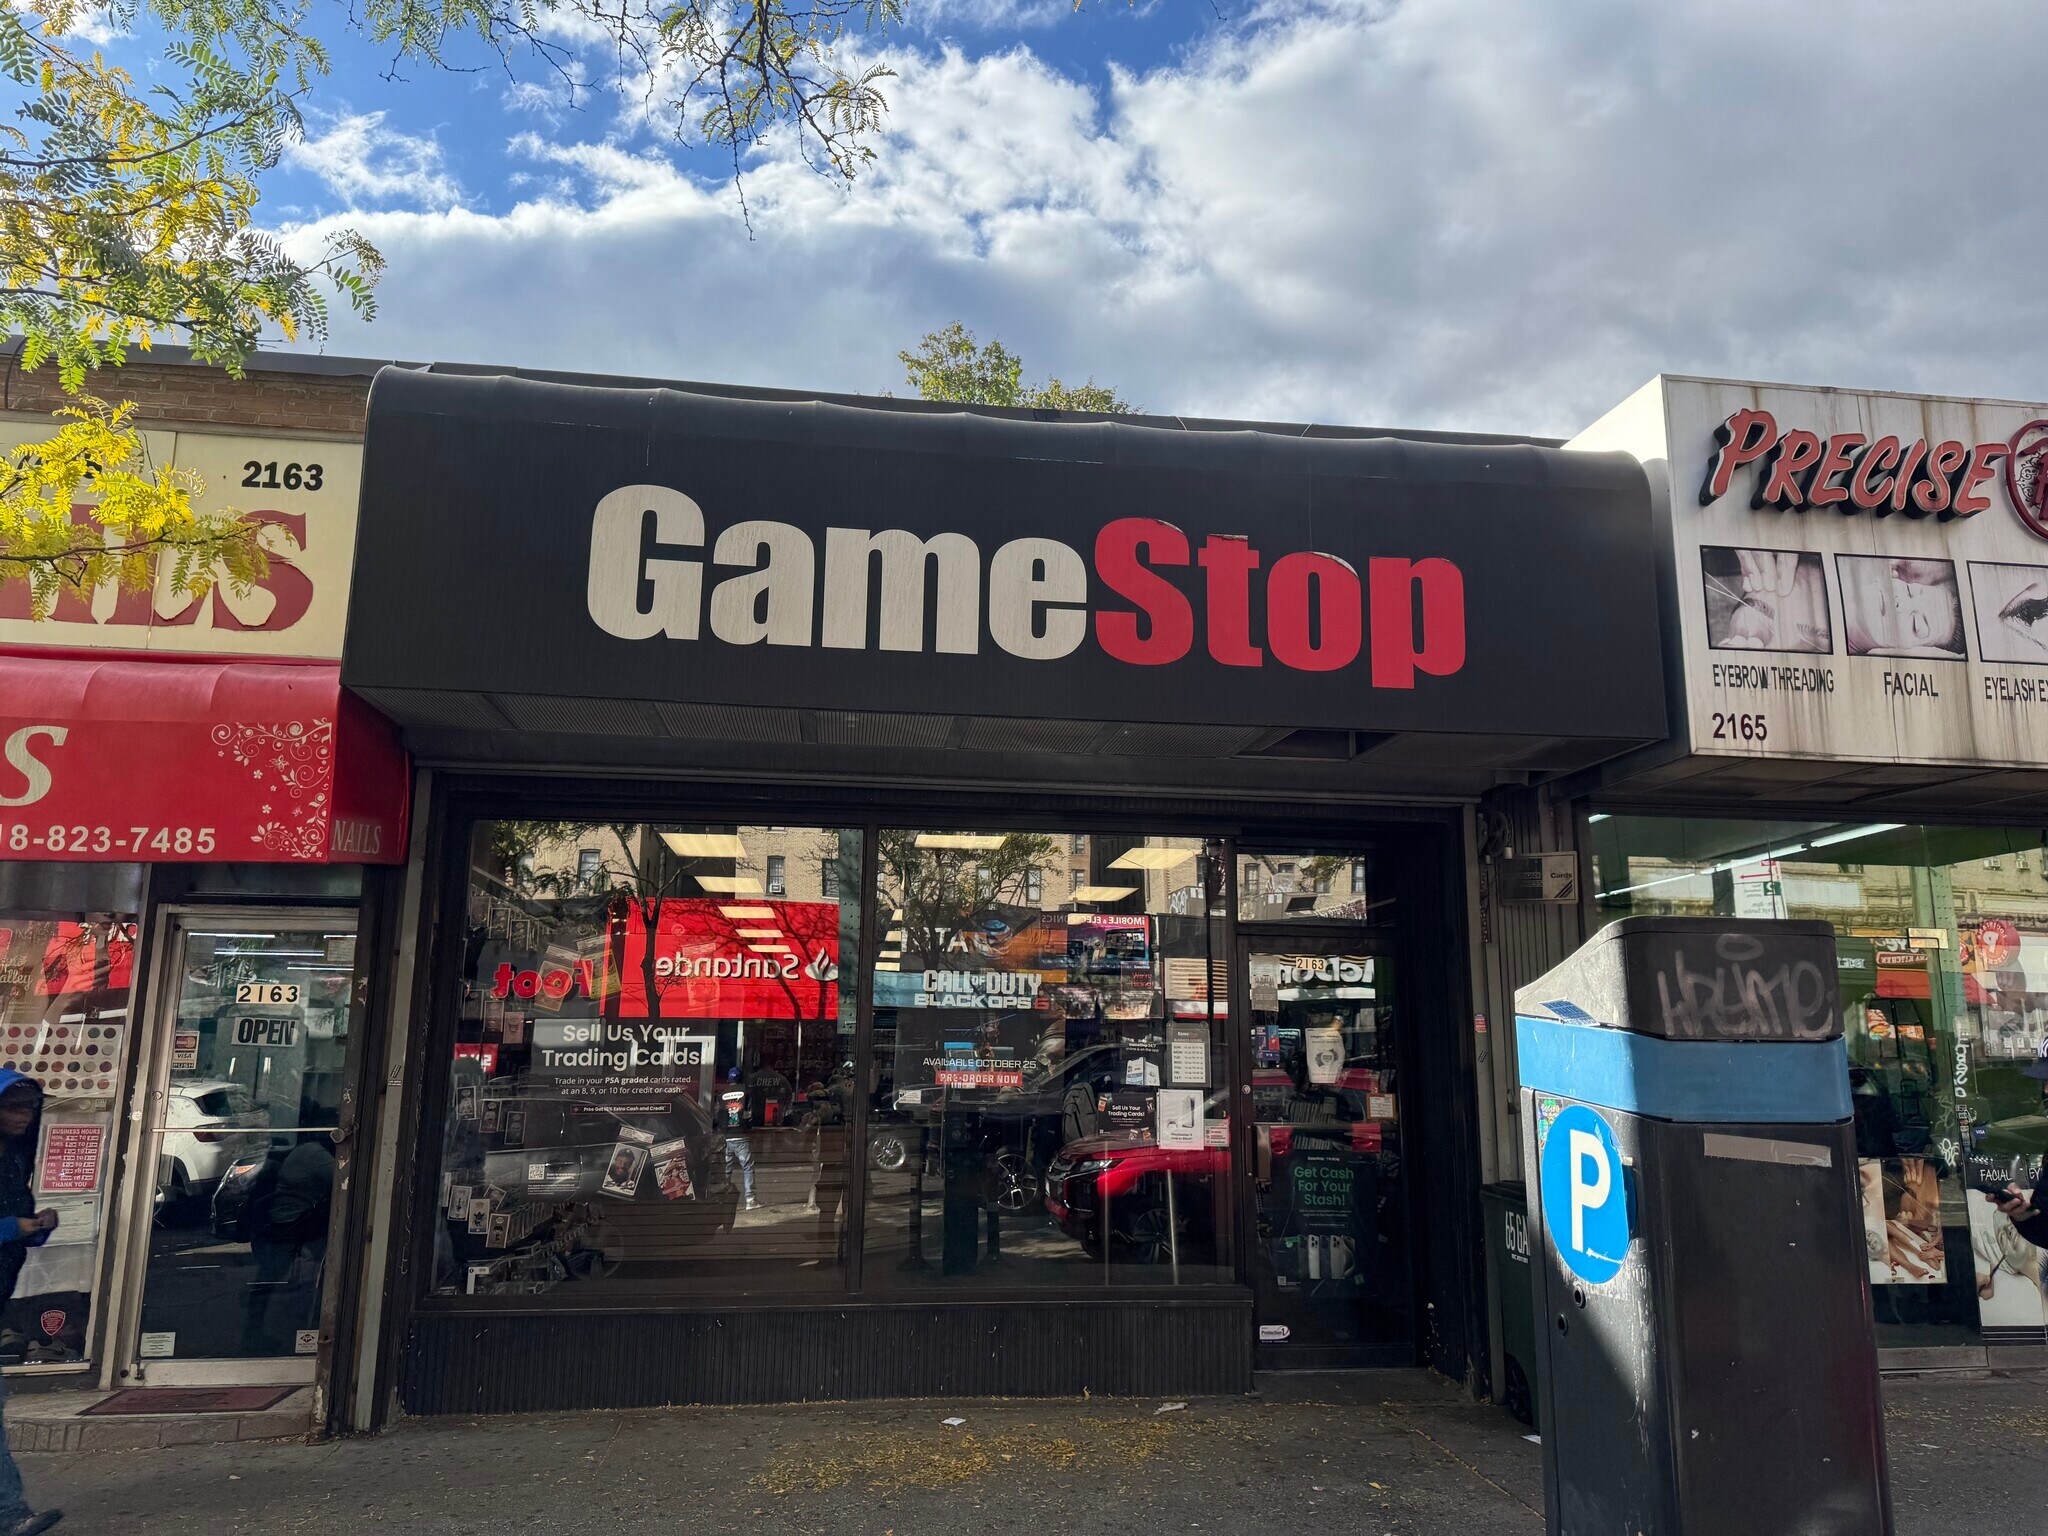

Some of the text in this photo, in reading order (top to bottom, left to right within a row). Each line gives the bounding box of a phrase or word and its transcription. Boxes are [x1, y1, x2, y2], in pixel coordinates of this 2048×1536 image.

[1708, 408, 2012, 514] PRECISE
[241, 460, 324, 491] 2163
[587, 484, 1467, 690] GameStop
[1712, 663, 1834, 693] EYEBROW THREADING
[1883, 671, 1939, 697] FACIAL
[1984, 676, 2048, 702] EYELASH E
[1712, 712, 1767, 741] 2165
[331, 819, 382, 855] NAILS
[1297, 958, 1325, 970] 2163
[923, 969, 974, 993] CALL
[986, 971, 1042, 996] DUTY
[237, 985, 299, 1003] 2163
[914, 993, 1050, 1010] BLACK OPS 6
[237, 1018, 296, 1046] OPEN
[562, 1023, 690, 1043] Sell Us Your
[541, 1048, 628, 1072] Trading
[922, 1057, 974, 1067] AVAILABLE
[976, 1058, 1021, 1069] OCTOBER
[555, 1077, 576, 1085] Trade
[586, 1079, 603, 1087] your
[621, 1076, 649, 1087] graded
[756, 1077, 780, 1087] CREW
[940, 1073, 1019, 1084] PRE-ORDER NOW
[581, 1087, 589, 1096] 8,
[590, 1087, 598, 1096] 9,
[619, 1086, 630, 1094] for
[631, 1086, 653, 1094] credit
[1294, 1166, 1354, 1179] Get Cash
[1980, 1169, 2012, 1182] FACIAL
[1298, 1180, 1352, 1192] For Your
[1569, 1129, 1612, 1253] P
[1304, 1193, 1346, 1206] Stash!
[1505, 1210, 1531, 1256] 65 GA
